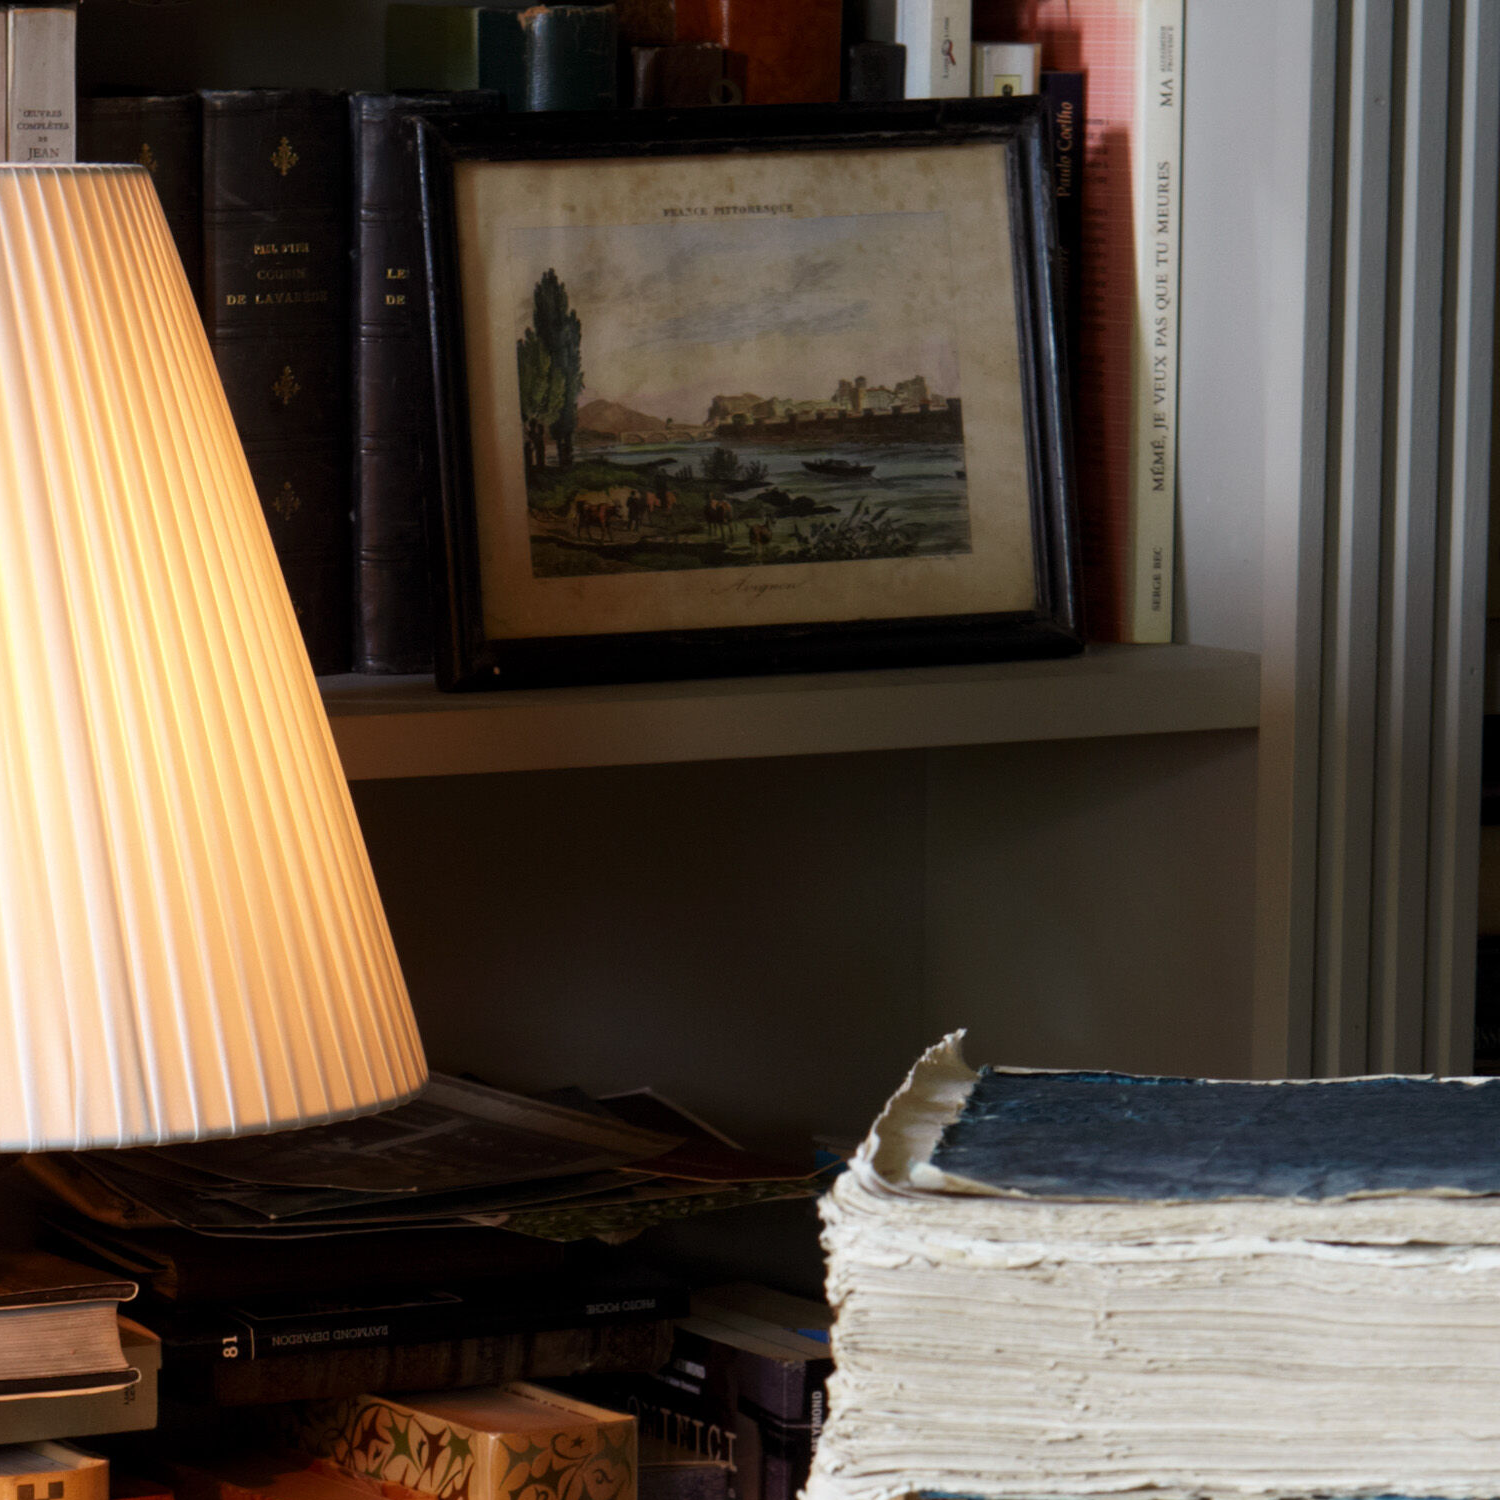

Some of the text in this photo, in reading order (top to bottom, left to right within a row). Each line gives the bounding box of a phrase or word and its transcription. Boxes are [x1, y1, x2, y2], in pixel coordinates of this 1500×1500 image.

[27, 147, 60, 160] JEAN
[1056, 101, 1073, 199] Paulo Coelho
[1157, 161, 1170, 236] MEURES
[1156, 241, 1169, 268] TU
[225, 293, 247, 307] DE
[1155, 272, 1170, 312] QUE
[1155, 314, 1167, 349] PAS
[1153, 355, 1167, 410] VEUX
[1153, 411, 1169, 431] JE
[1152, 564, 1161, 612] SERGE
[221, 1335, 239, 1359] 81
[271, 1325, 389, 1347] RAYMOND DEPARDON
